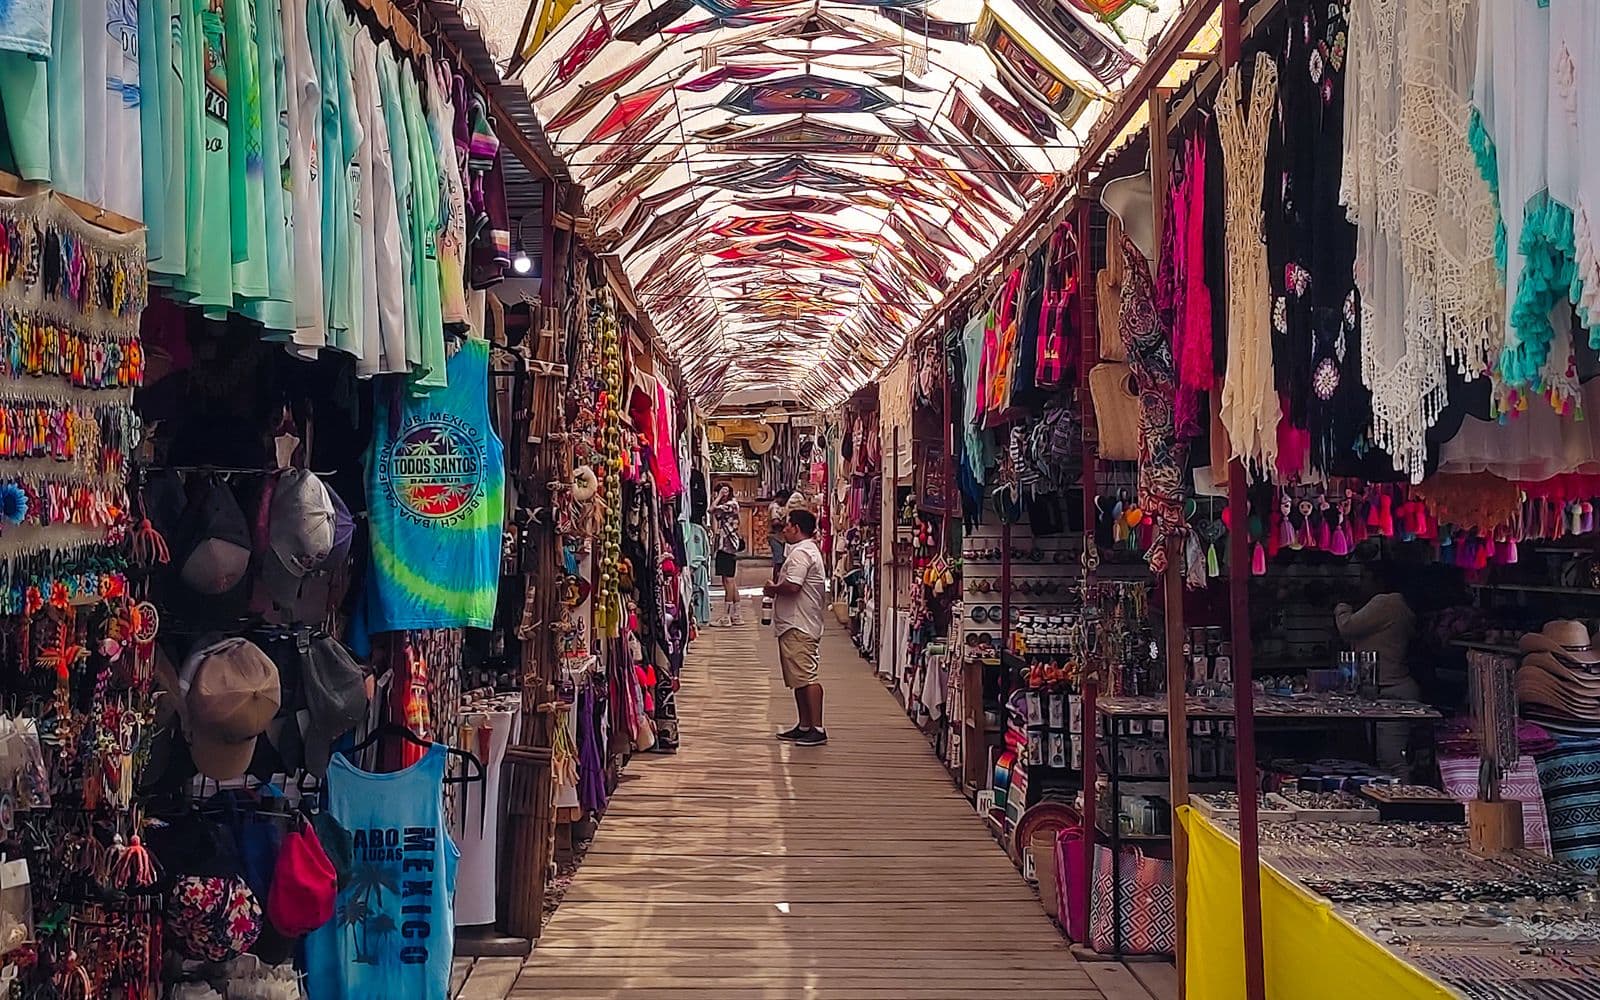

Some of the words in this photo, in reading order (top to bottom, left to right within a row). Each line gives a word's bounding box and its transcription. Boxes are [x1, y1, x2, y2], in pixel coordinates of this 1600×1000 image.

[429, 412, 478, 437] MEXICO
[379, 438, 398, 509] CALIFORNI
[393, 458, 431, 475] TODOS
[434, 456, 477, 474] SANTOS
[400, 508, 430, 529] BAJA
[441, 499, 480, 528] BEACH
[353, 828, 399, 849] ABO
[363, 848, 403, 861] LUCAS
[400, 827, 435, 965] MEXICO
